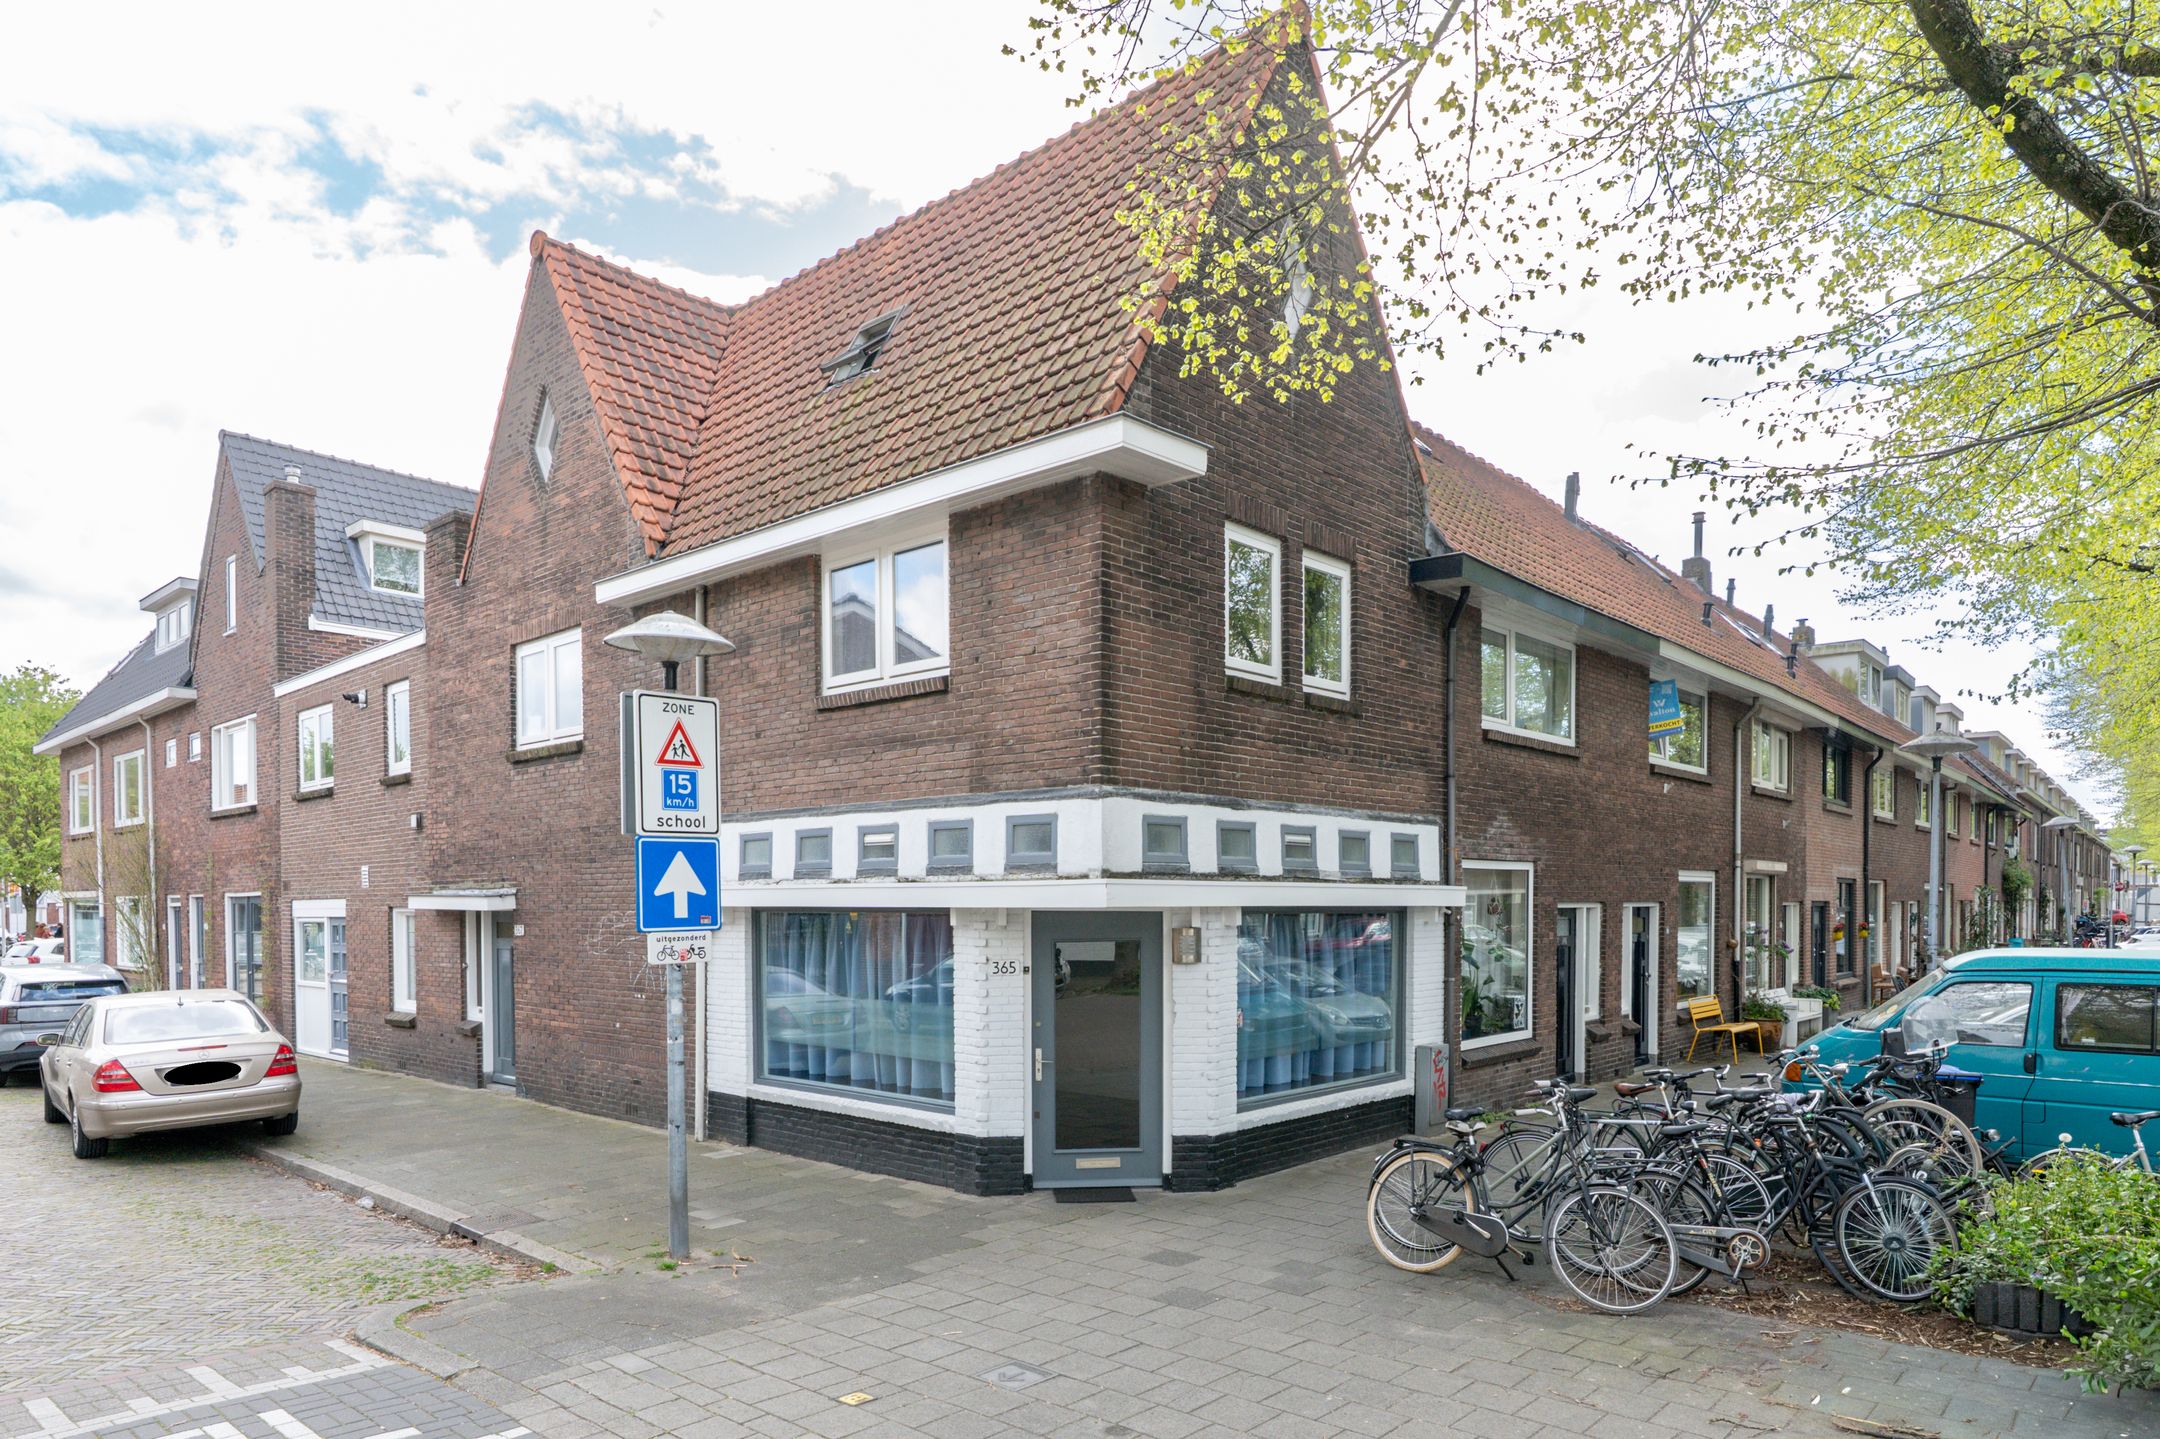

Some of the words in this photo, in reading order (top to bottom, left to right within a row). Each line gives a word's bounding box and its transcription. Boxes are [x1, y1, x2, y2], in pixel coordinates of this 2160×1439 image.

[662, 702, 695, 715] ZONE
[669, 774, 692, 795] 15
[666, 797, 695, 807] km/h
[657, 815, 706, 829] school
[656, 934, 706, 943] uitgezonderd
[992, 961, 1016, 975] 365
